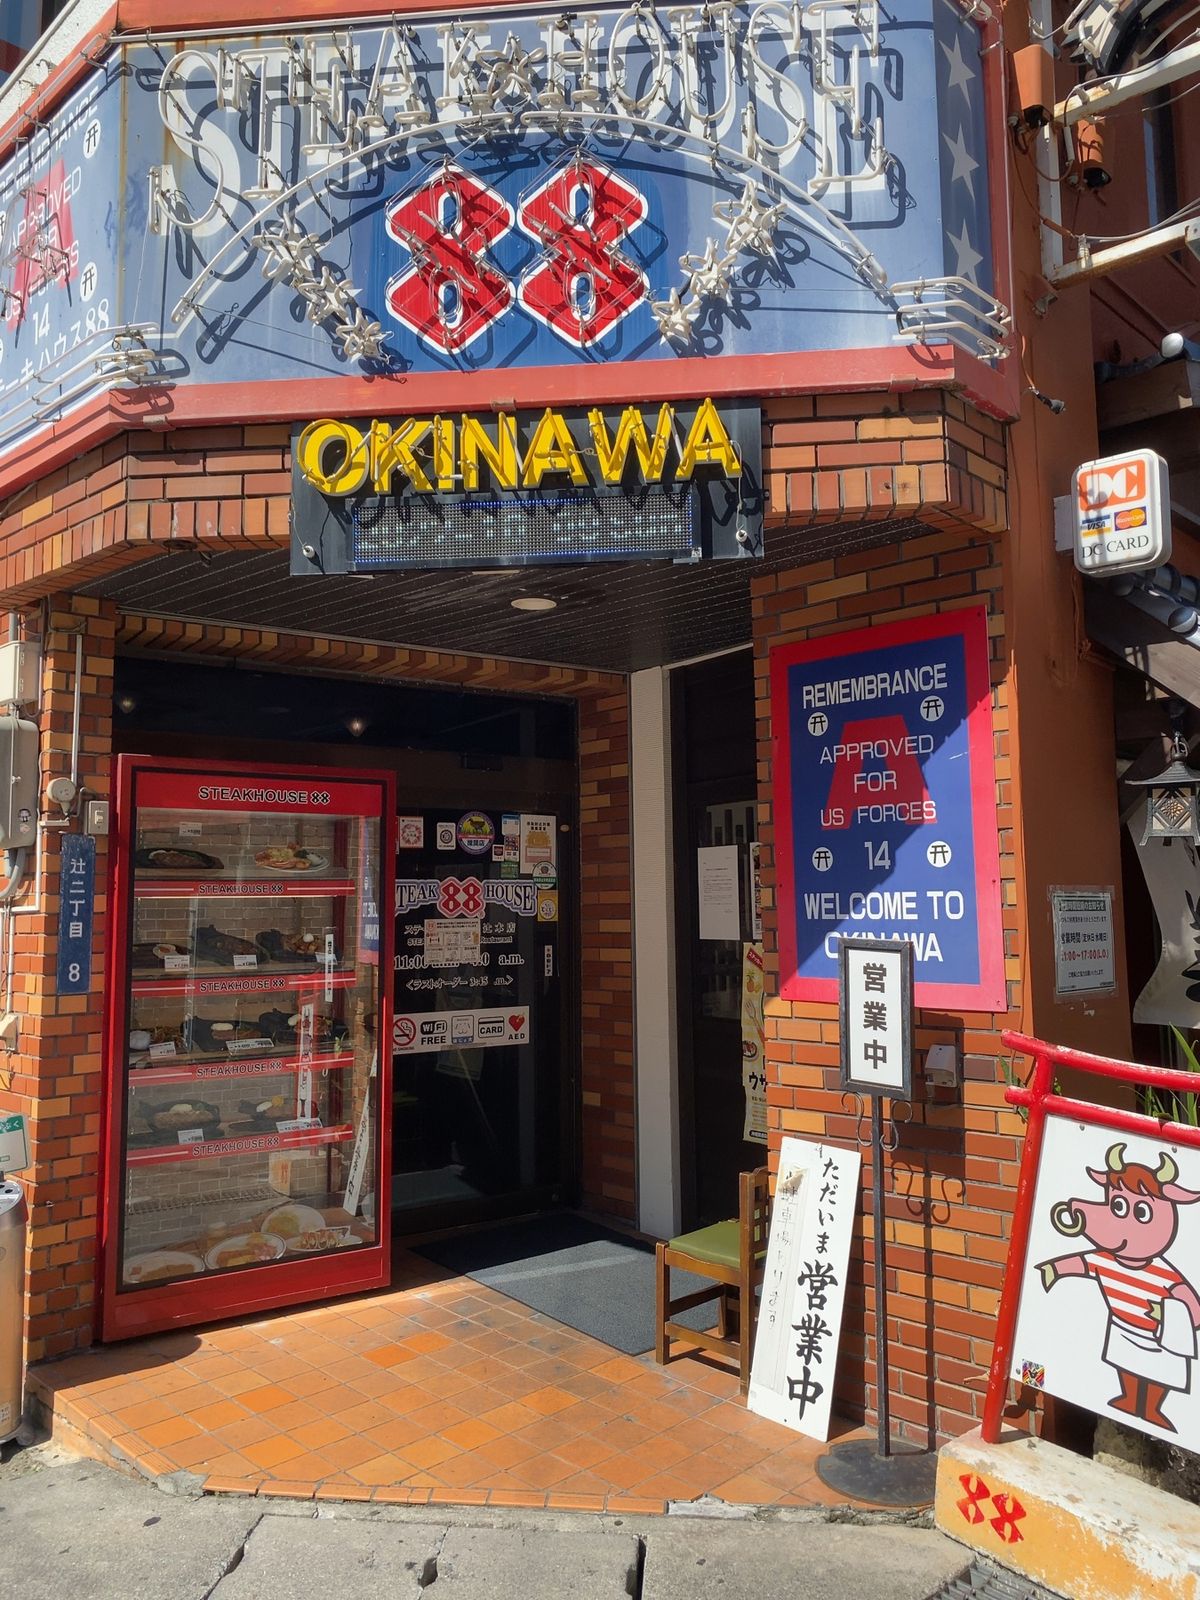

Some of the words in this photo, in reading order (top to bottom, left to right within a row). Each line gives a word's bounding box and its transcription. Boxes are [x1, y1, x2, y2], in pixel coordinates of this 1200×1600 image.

[148, 20, 492, 236] STEAK
[535, 0, 888, 195] HOUSE
[384, 160, 651, 355] 88
[32, 302, 50, 346] 14
[297, 397, 743, 496] OKINAWA
[1087, 520, 1106, 531] VISA
[1082, 543, 1103, 559] DC
[1106, 534, 1149, 554] CARD
[803, 663, 948, 709] REMEMBRANCE
[819, 734, 934, 765] APPROVED
[853, 770, 897, 793] FOR
[199, 786, 308, 804] STEAKHOUSE
[310, 791, 331, 805] 88
[820, 809, 844, 827] US
[857, 801, 937, 825] FORCES
[863, 841, 892, 871] 14
[69, 858, 86, 939] 辻二丁目
[199, 883, 269, 894] STEAKHOUSE
[396, 884, 437, 909] TEAK
[441, 881, 482, 915] 88
[485, 884, 533, 911] HOUSE
[804, 891, 918, 920] WELCOME
[926, 890, 965, 920] TO
[68, 962, 80, 983] 8
[200, 980, 270, 992] STEAKHOUSE
[862, 962, 888, 1070] 営業中
[420, 1035, 447, 1046] FREE
[508, 1032, 526, 1041] AED
[480, 1026, 503, 1035] CARD
[196, 1063, 267, 1077] STEAKHOUSE
[192, 1138, 265, 1156] STEAKHOUSE
